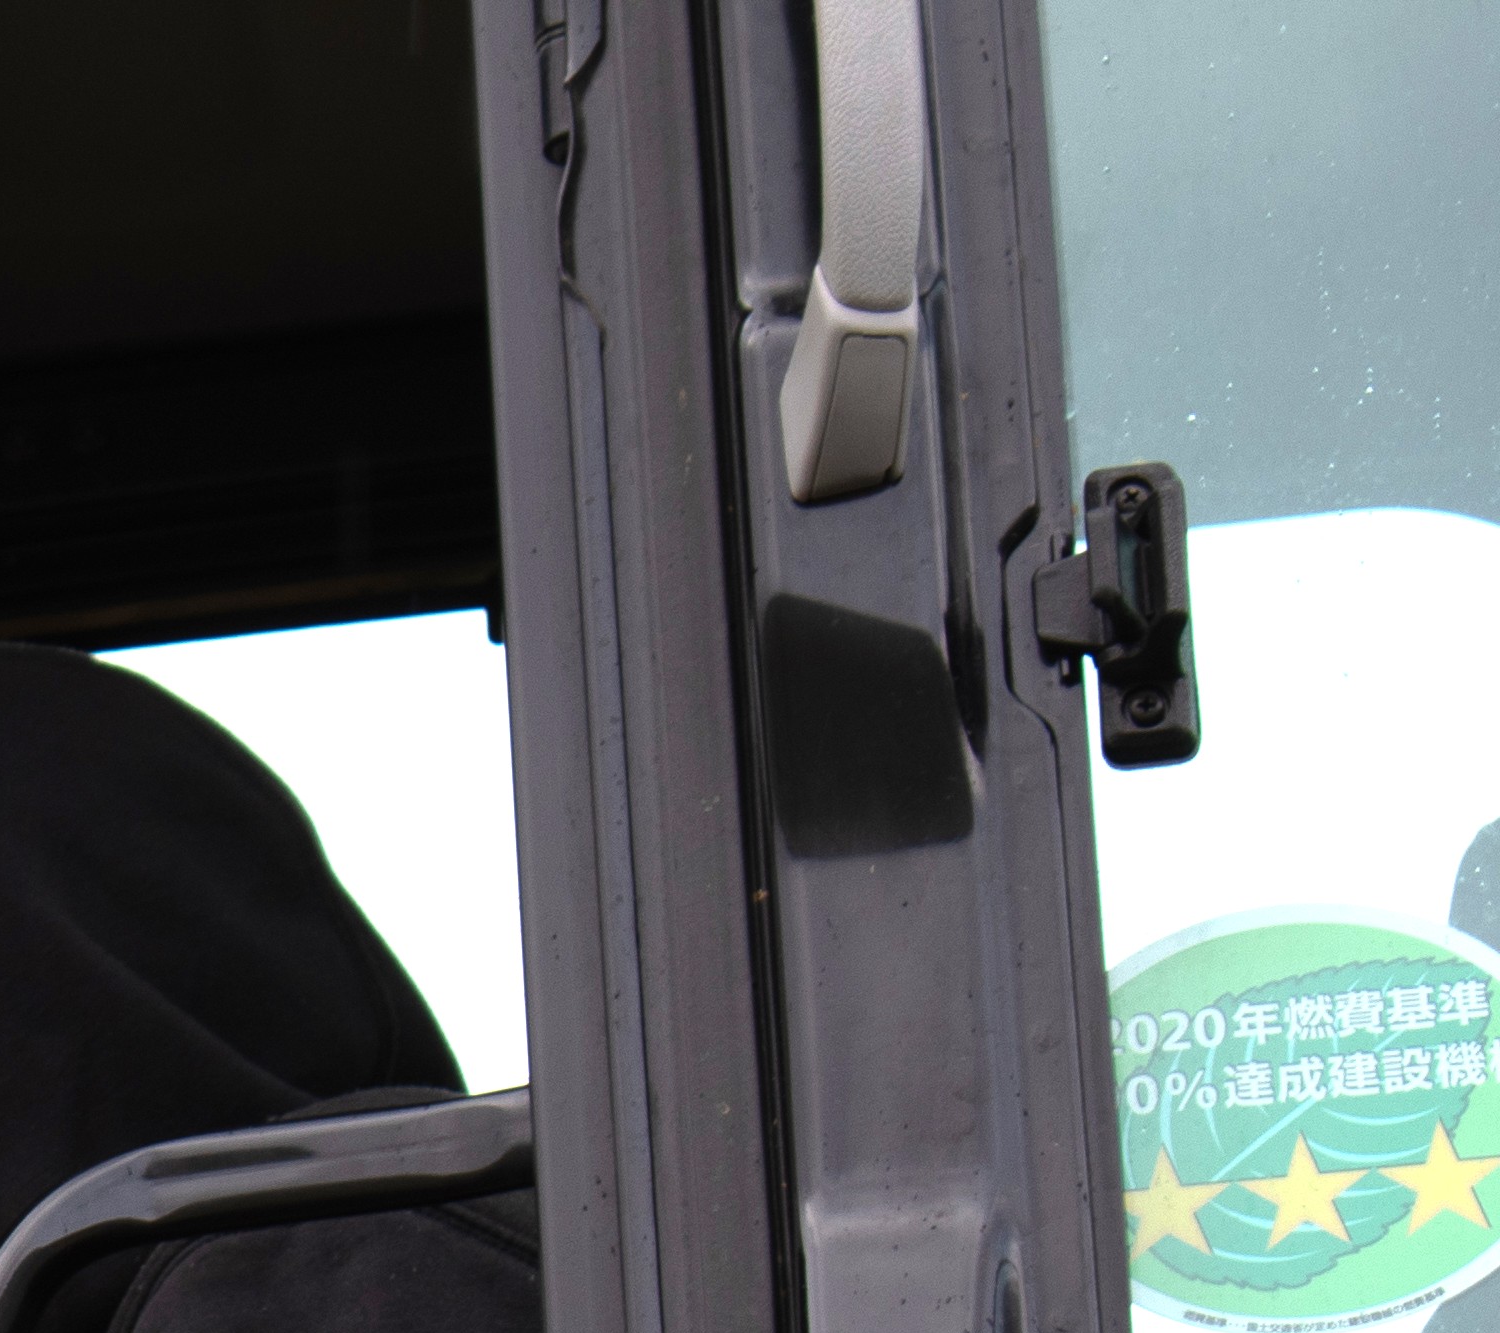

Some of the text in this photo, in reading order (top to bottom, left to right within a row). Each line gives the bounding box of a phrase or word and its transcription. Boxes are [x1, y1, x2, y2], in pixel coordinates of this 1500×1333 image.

[1126, 1036, 1500, 1116] 0%達成建設機
